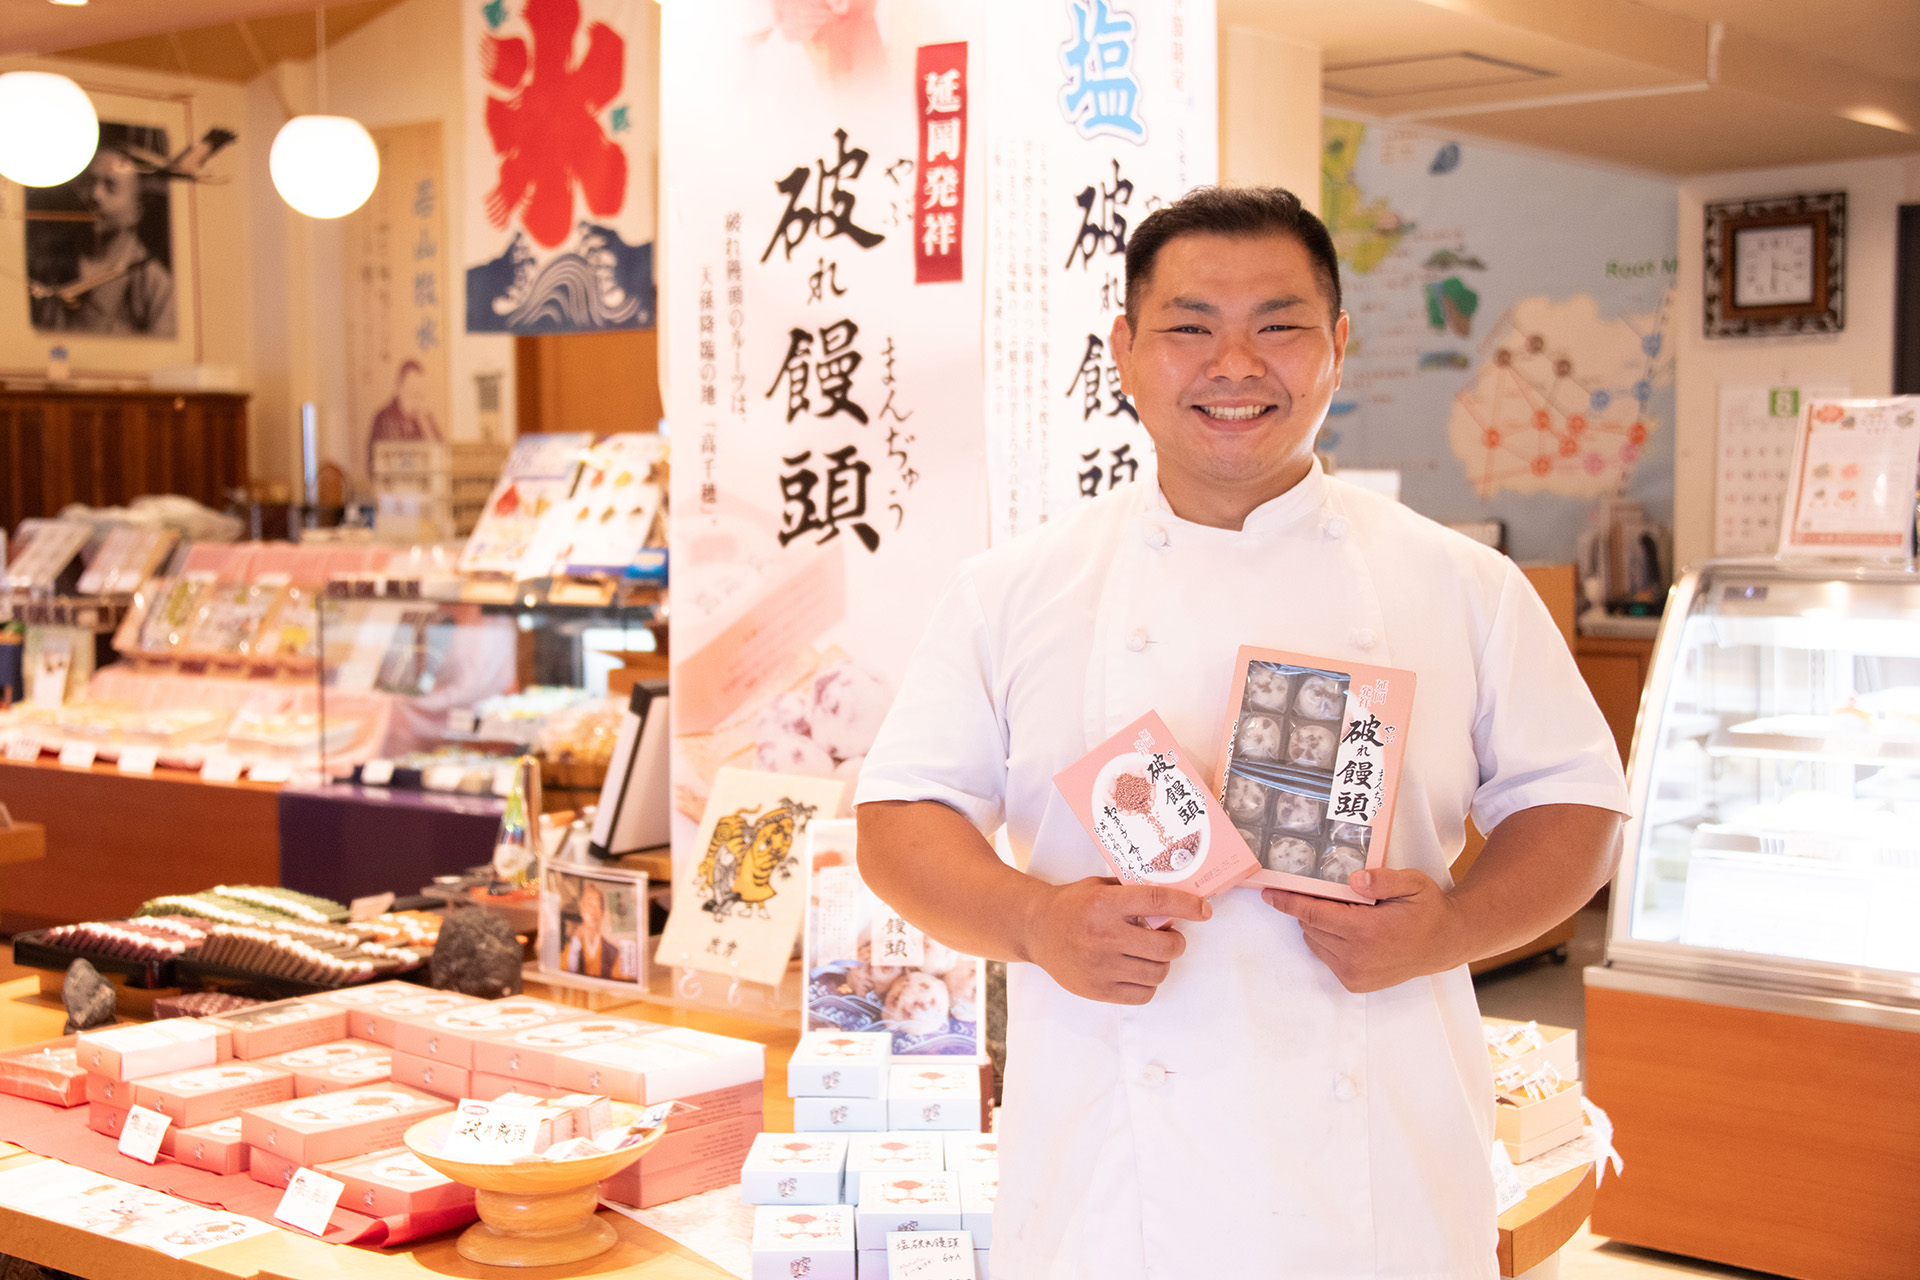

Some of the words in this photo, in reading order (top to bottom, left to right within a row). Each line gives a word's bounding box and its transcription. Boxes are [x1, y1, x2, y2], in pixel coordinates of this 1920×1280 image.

[1065, 0, 1143, 135] 塩
[922, 68, 961, 256] 延岡発祥
[761, 127, 886, 553] 破れ饅頭
[1359, 684, 1374, 708] 発祥
[1373, 680, 1389, 705] 延岡
[1147, 753, 1205, 826] 破れ饅頭
[1334, 714, 1385, 822] 破れ饅頭
